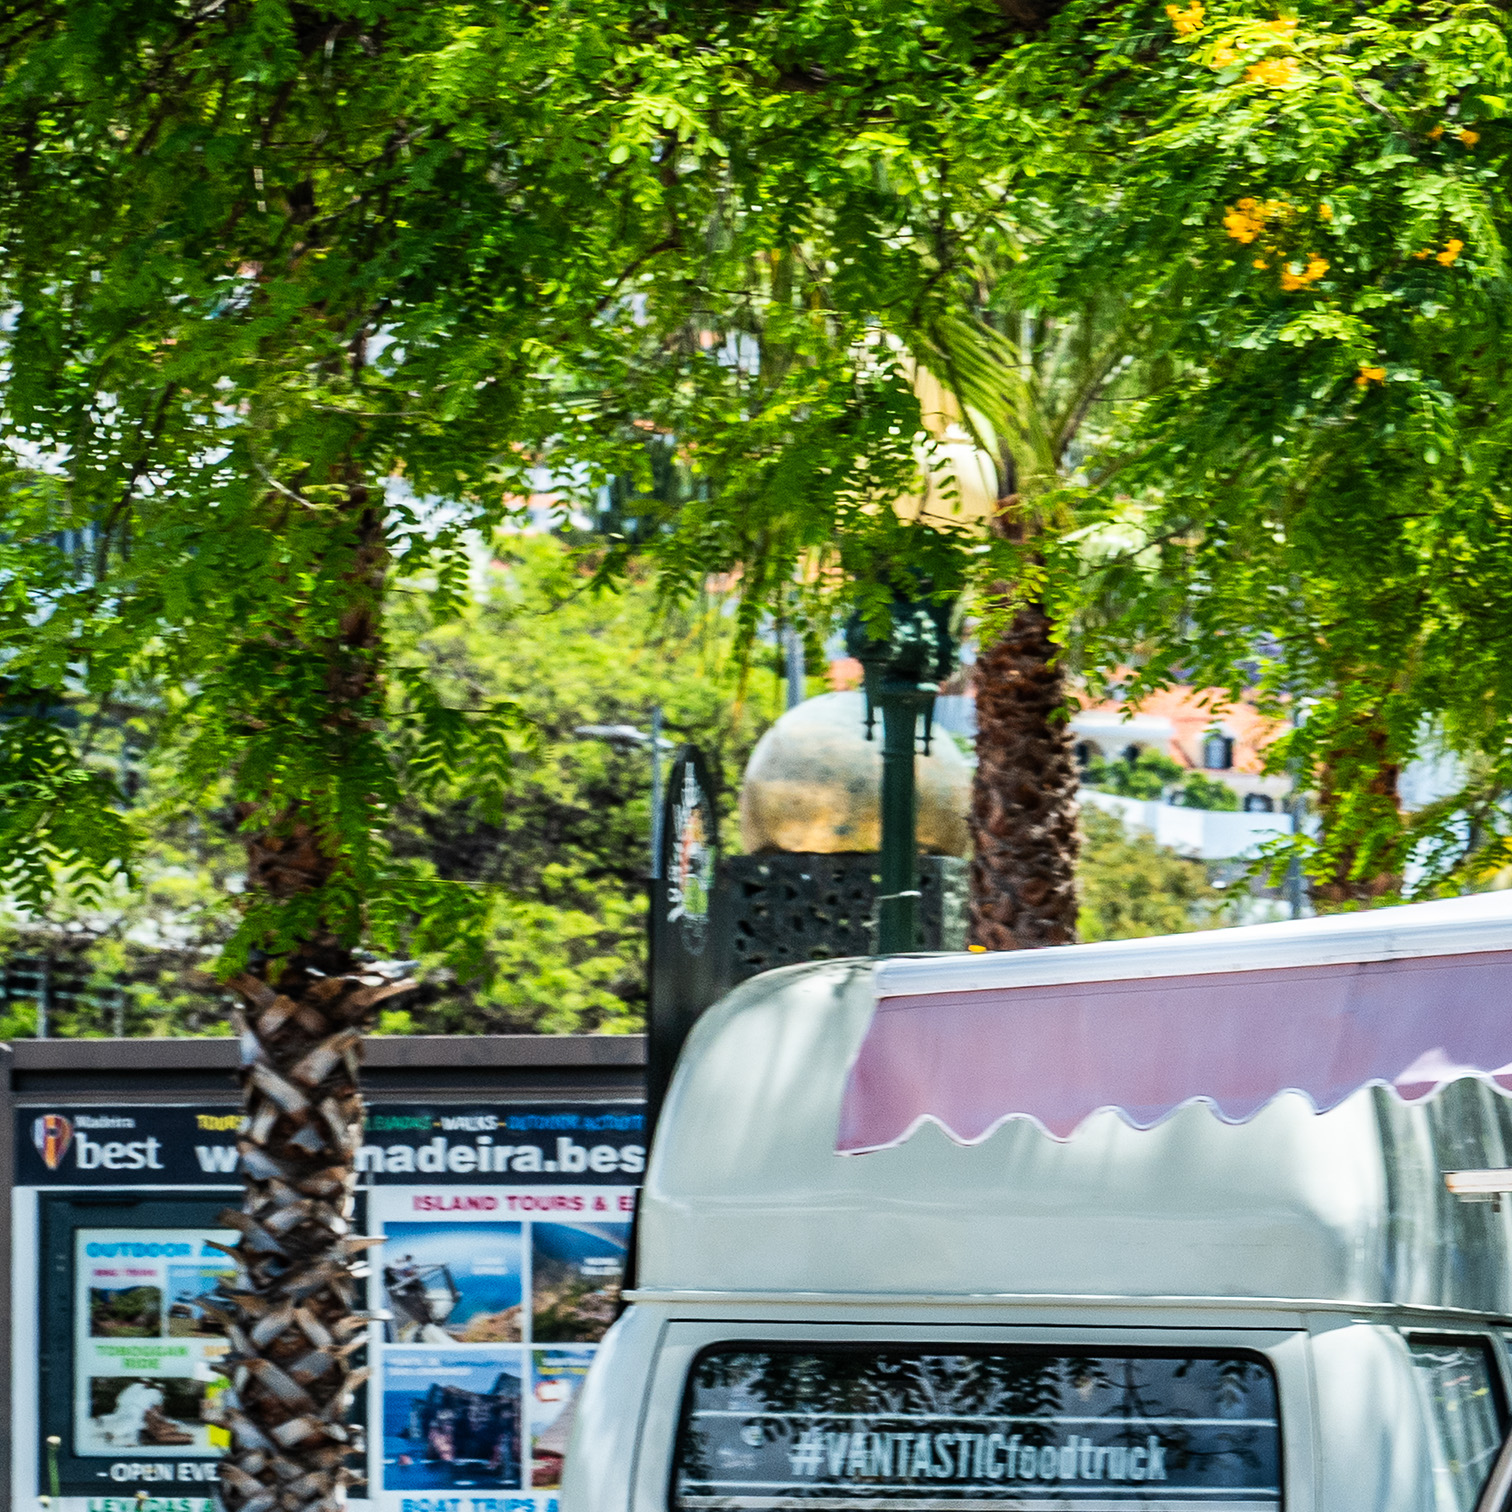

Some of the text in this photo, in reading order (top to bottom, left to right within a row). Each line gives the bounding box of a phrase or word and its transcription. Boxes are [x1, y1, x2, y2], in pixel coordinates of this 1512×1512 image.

[74, 1132, 165, 1169] best
[412, 1195, 498, 1211] ISLAND
[505, 1195, 585, 1211] TOURS
[591, 1196, 609, 1211] &
